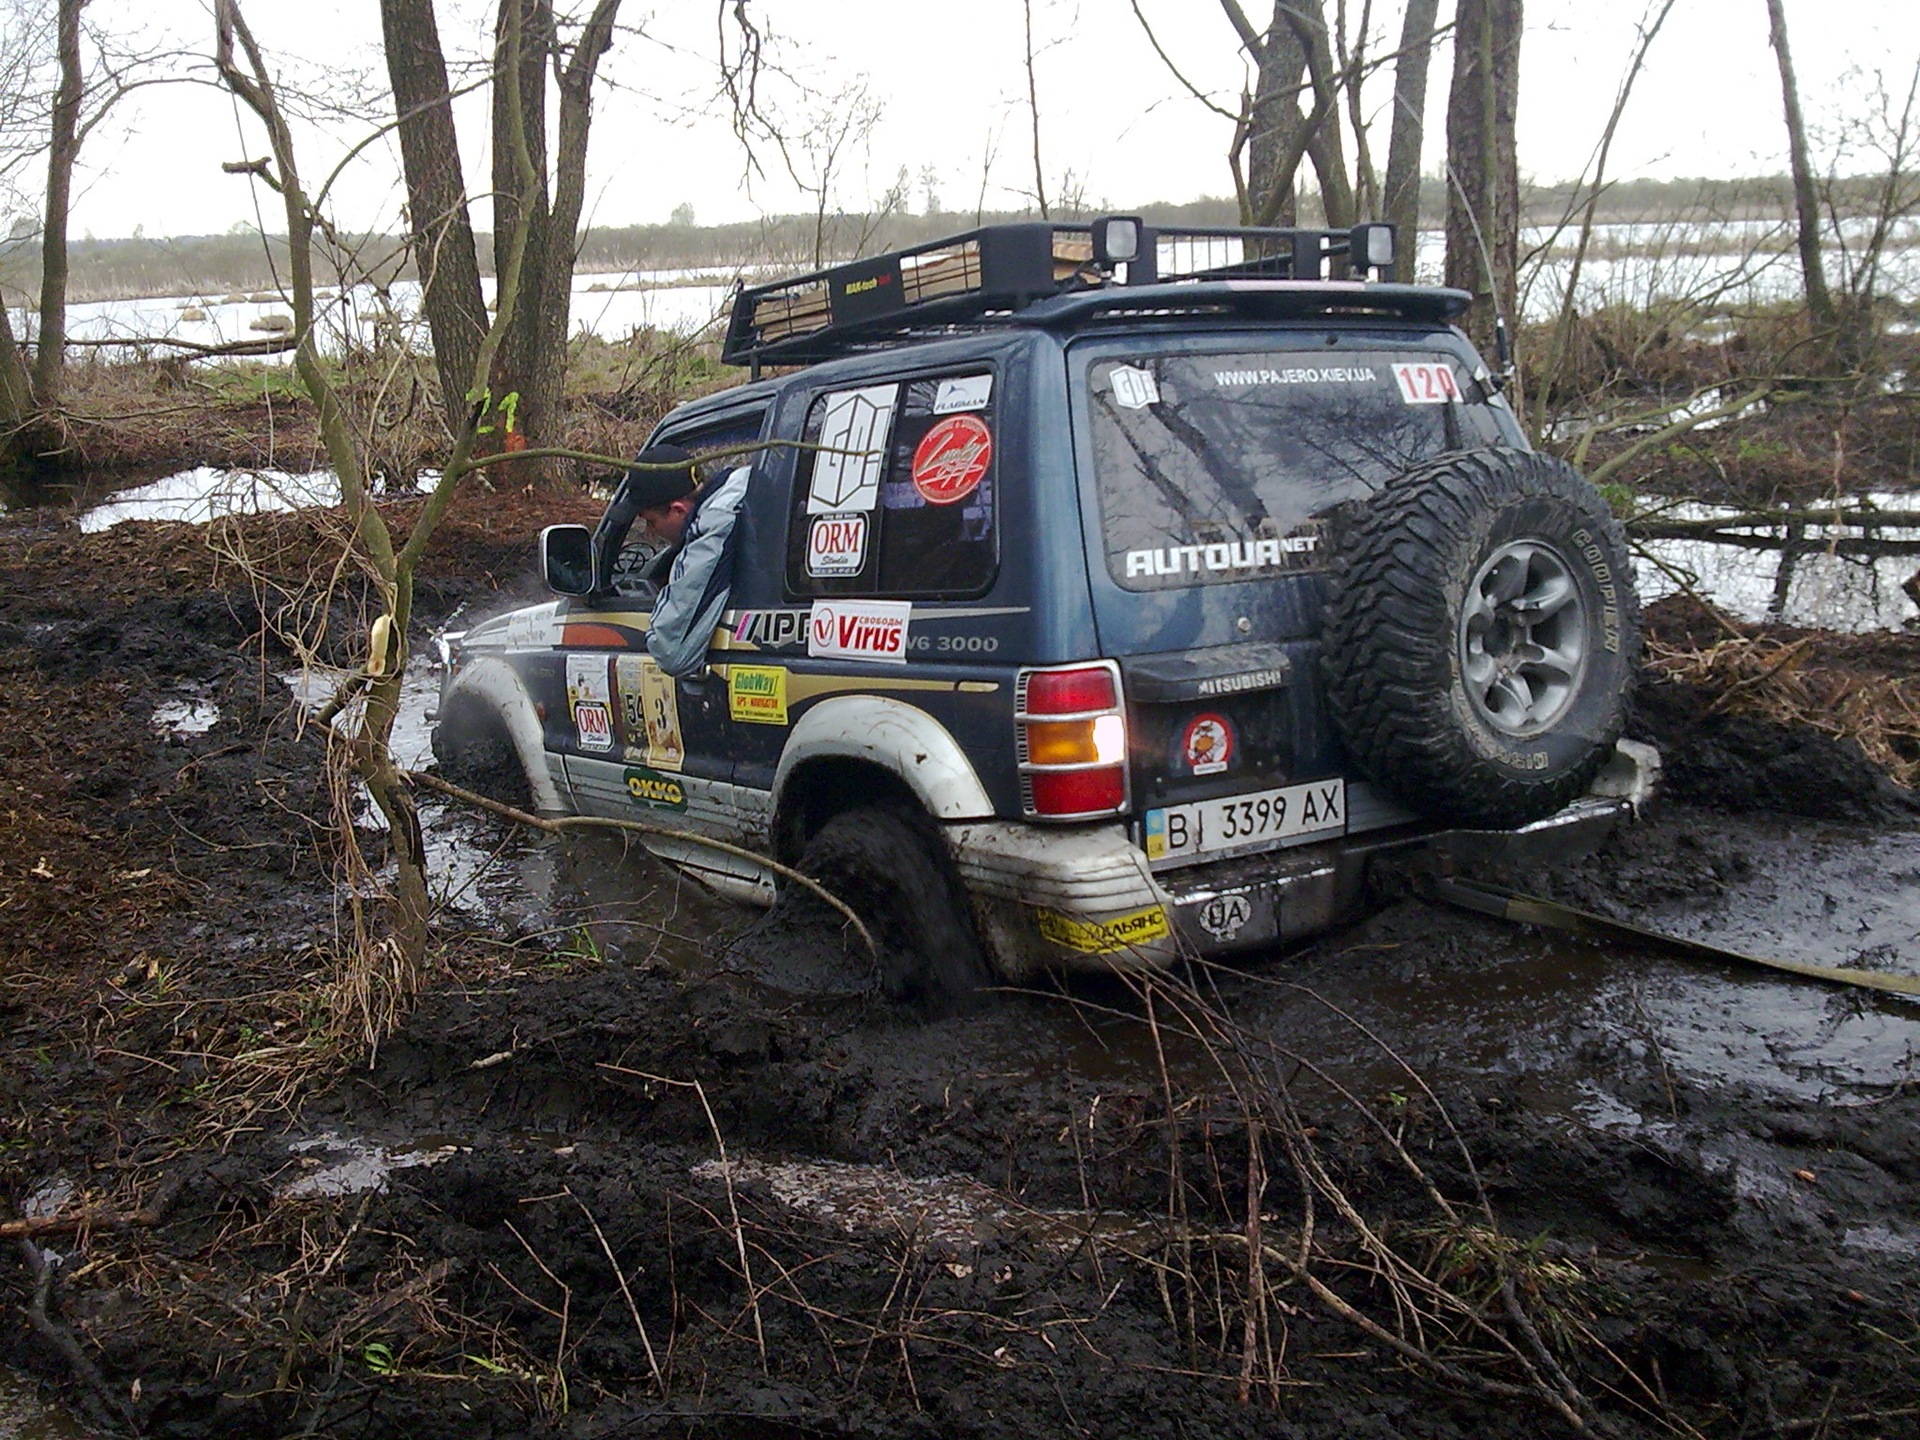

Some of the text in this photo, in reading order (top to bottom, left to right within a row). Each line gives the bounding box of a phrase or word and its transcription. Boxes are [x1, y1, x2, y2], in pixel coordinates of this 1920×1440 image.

[1213, 367, 1376, 386] WWW.PAJERO.KIEV.UA
[1400, 367, 1457, 398] 120
[815, 522, 861, 555] ORM
[839, 615, 901, 652] Virus
[859, 616, 903, 626] СВОБОДЫ
[906, 635, 999, 652] V6 3000
[578, 708, 608, 734] ORM
[654, 698, 667, 730] 3
[629, 777, 682, 804] OKKO
[1168, 785, 1339, 849] BI 3399 AX
